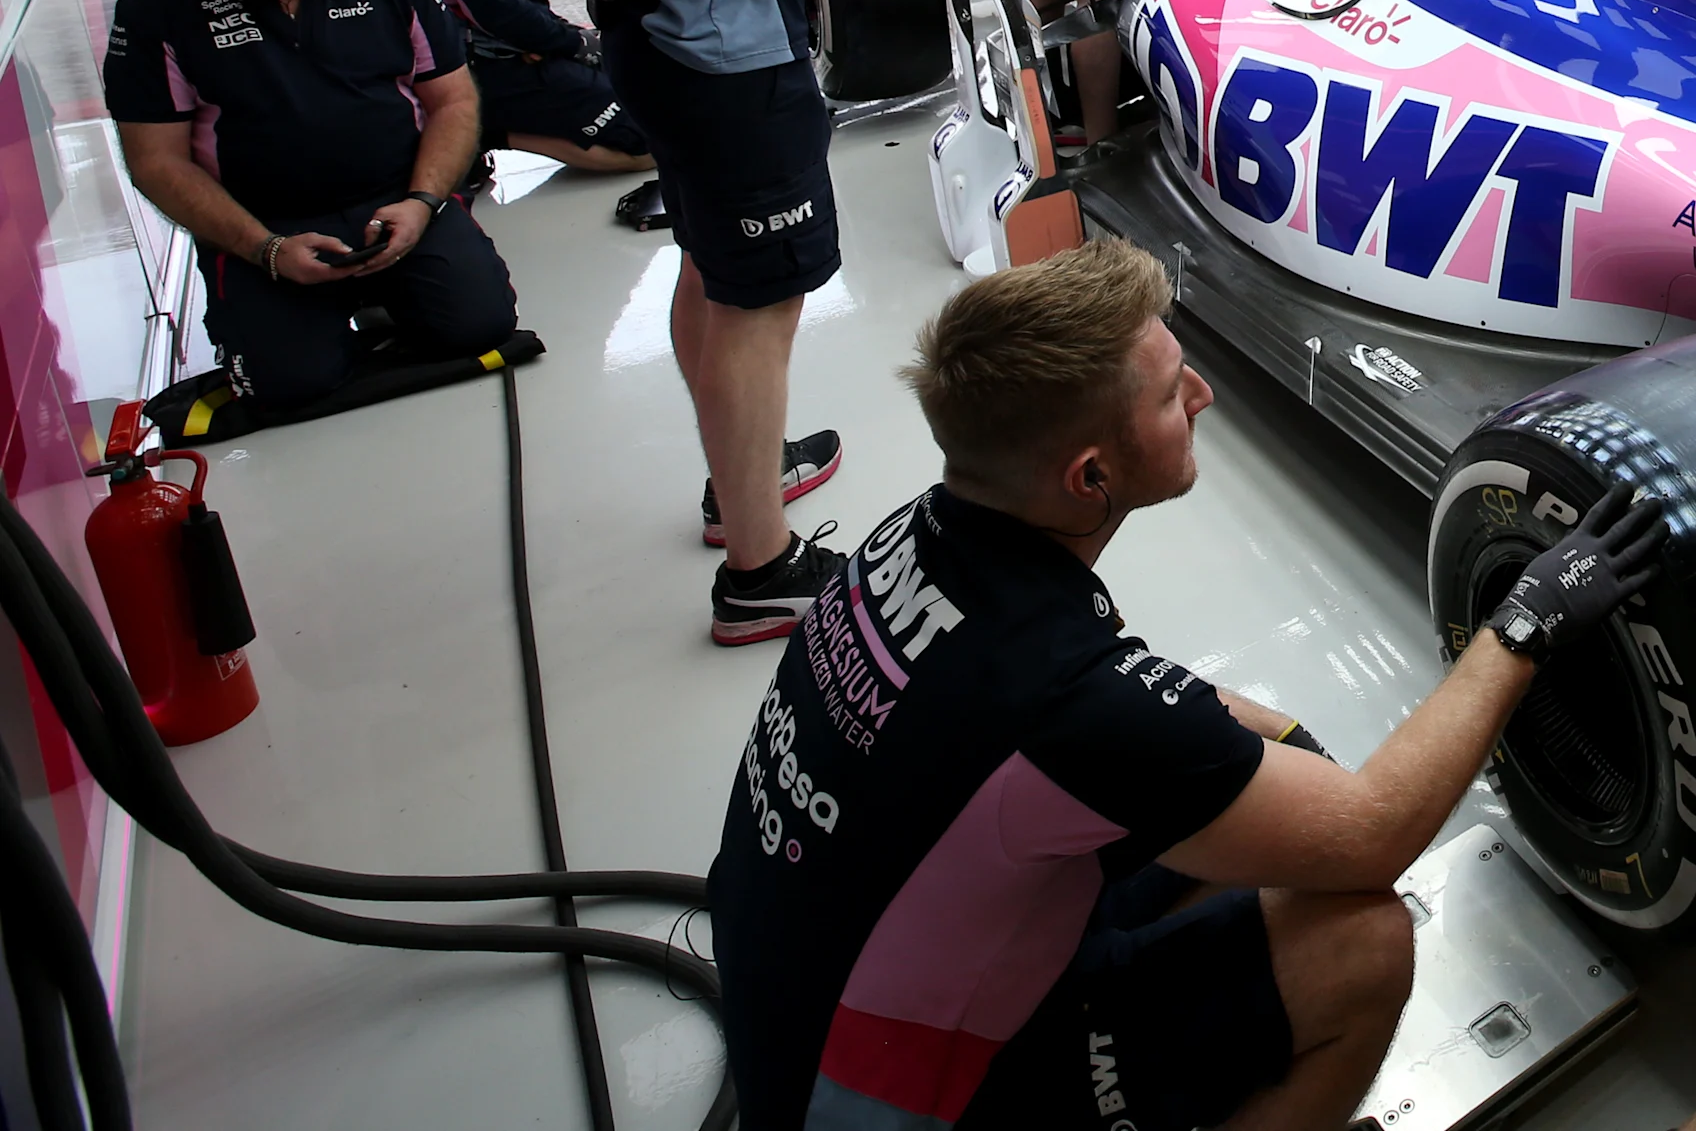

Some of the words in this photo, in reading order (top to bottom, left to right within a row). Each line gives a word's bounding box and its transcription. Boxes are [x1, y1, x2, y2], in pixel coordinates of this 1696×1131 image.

[209, 12, 256, 32] NEC
[329, 5, 368, 20] Claro
[594, 102, 621, 127] BWT
[1215, 56, 1612, 310] BWT
[768, 200, 814, 232] BWT
[1373, 358, 1397, 374] ROAD
[1390, 371, 1423, 391] SAFETY
[1385, 355, 1422, 379] ACTION
[1532, 491, 1578, 525] P
[1558, 555, 1597, 590] HyFlex
[867, 534, 965, 662] BWT
[823, 683, 875, 756] WATER
[1089, 1031, 1127, 1117] BWT
